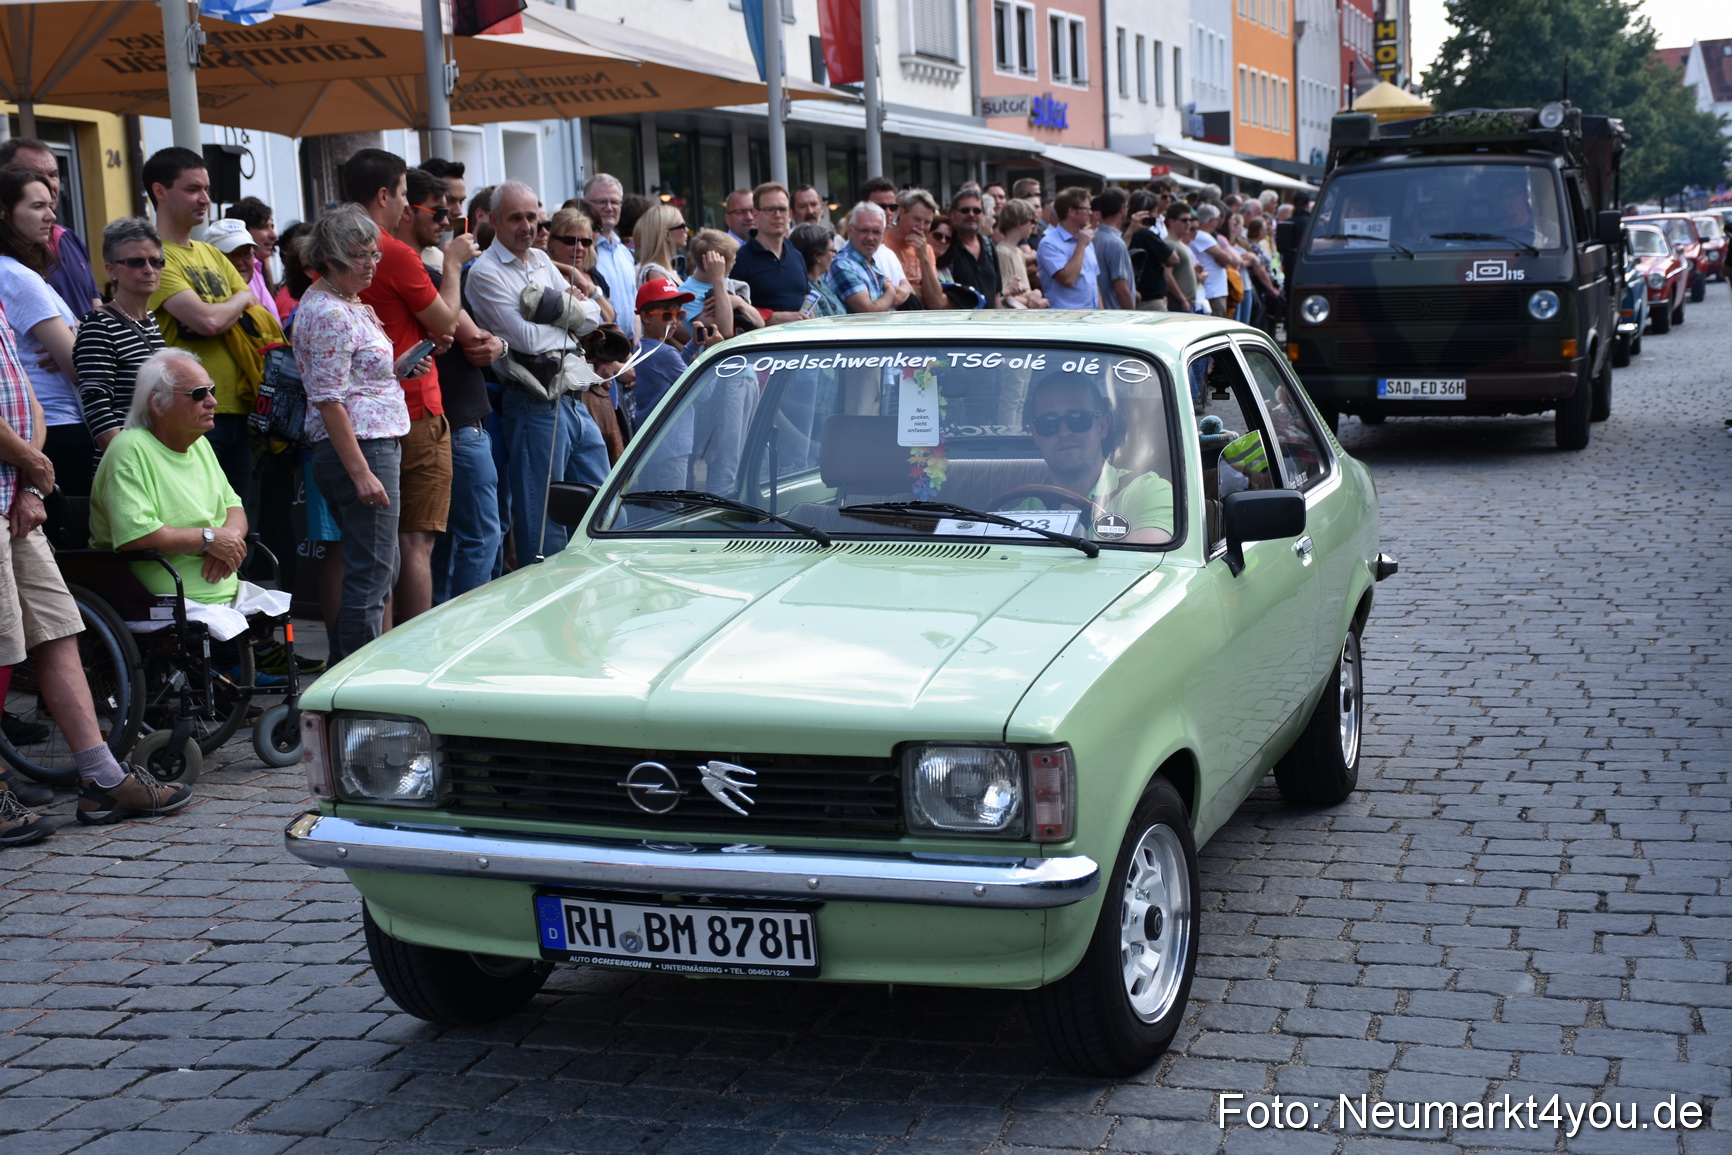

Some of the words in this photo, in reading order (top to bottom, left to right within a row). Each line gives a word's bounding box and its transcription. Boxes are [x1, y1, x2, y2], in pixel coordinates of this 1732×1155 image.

[106, 150, 122, 168] 24
[1366, 224, 1383, 233] 462
[1465, 270, 1473, 281] 3
[1507, 269, 1525, 280] 115
[752, 352, 937, 375] Opelschwenker
[947, 353, 1003, 368] TSG
[1009, 353, 1046, 370] olé
[1062, 357, 1100, 375] olé
[1387, 381, 1411, 394] SAD
[1421, 382, 1437, 394] ED
[1440, 382, 1464, 394] 36H
[1107, 516, 1115, 526] 1
[548, 928, 558, 939] D
[564, 904, 616, 948] RH
[643, 912, 697, 955] BM
[707, 915, 812, 960] 878H
[569, 955, 591, 963] AUTO
[591, 957, 652, 969] OCHSENKÜHN
[661, 963, 722, 974] UNTERMÄSSING
[729, 967, 747, 975] TEL.
[748, 968, 790, 977] 08463/1224
